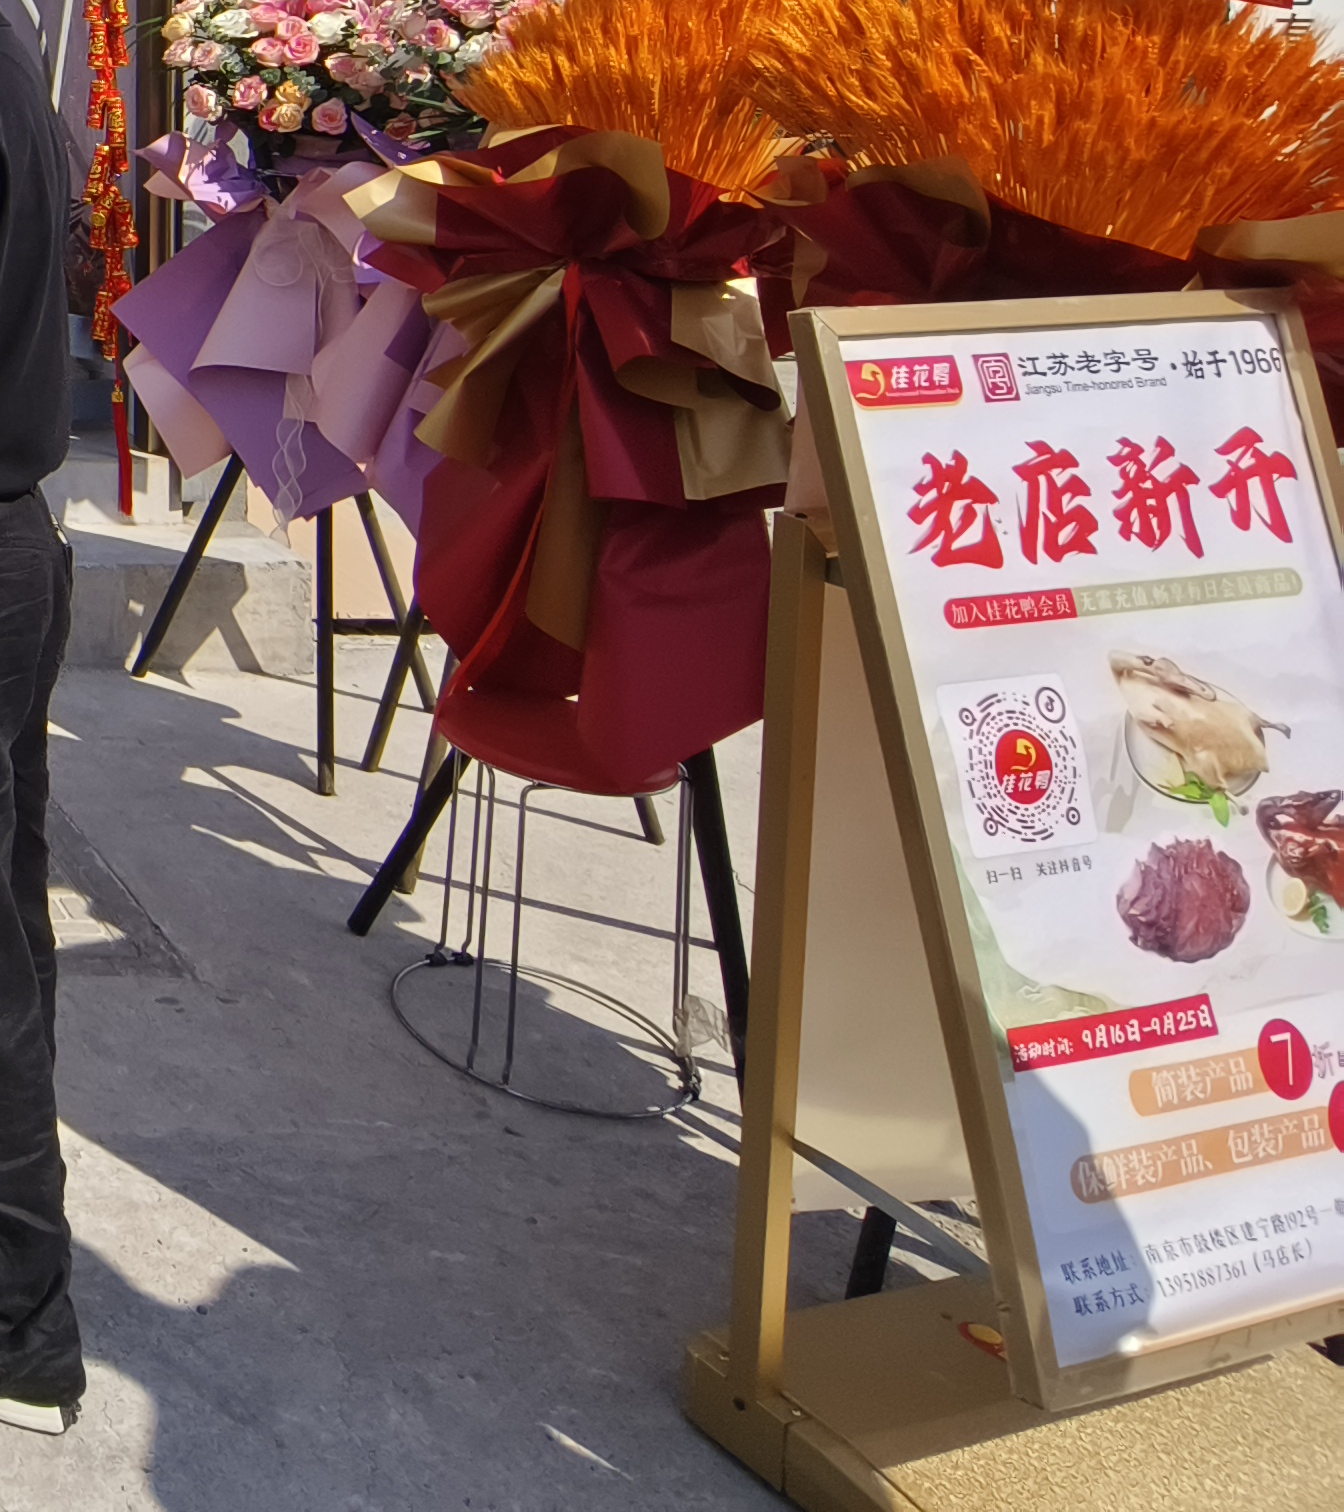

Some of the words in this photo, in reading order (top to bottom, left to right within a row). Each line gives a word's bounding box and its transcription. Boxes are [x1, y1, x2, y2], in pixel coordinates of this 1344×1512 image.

[890, 362, 951, 390] 桂花鸭
[1024, 383, 1063, 397] Jiangsu
[1064, 377, 1134, 392] Time-honored
[1135, 376, 1168, 389] Brand
[906, 425, 1298, 570] 老店新开
[951, 591, 1072, 626] 加入桂花鸭会员
[1002, 770, 1051, 794] 桂花鸭
[986, 867, 1023, 884] 扫一扫
[1036, 855, 1092, 876] 关注抖音号
[1082, 1004, 1213, 1049] 9月16日-9月25日
[1150, 1056, 1255, 1109] 简装产品
[1270, 1031, 1295, 1087] 7
